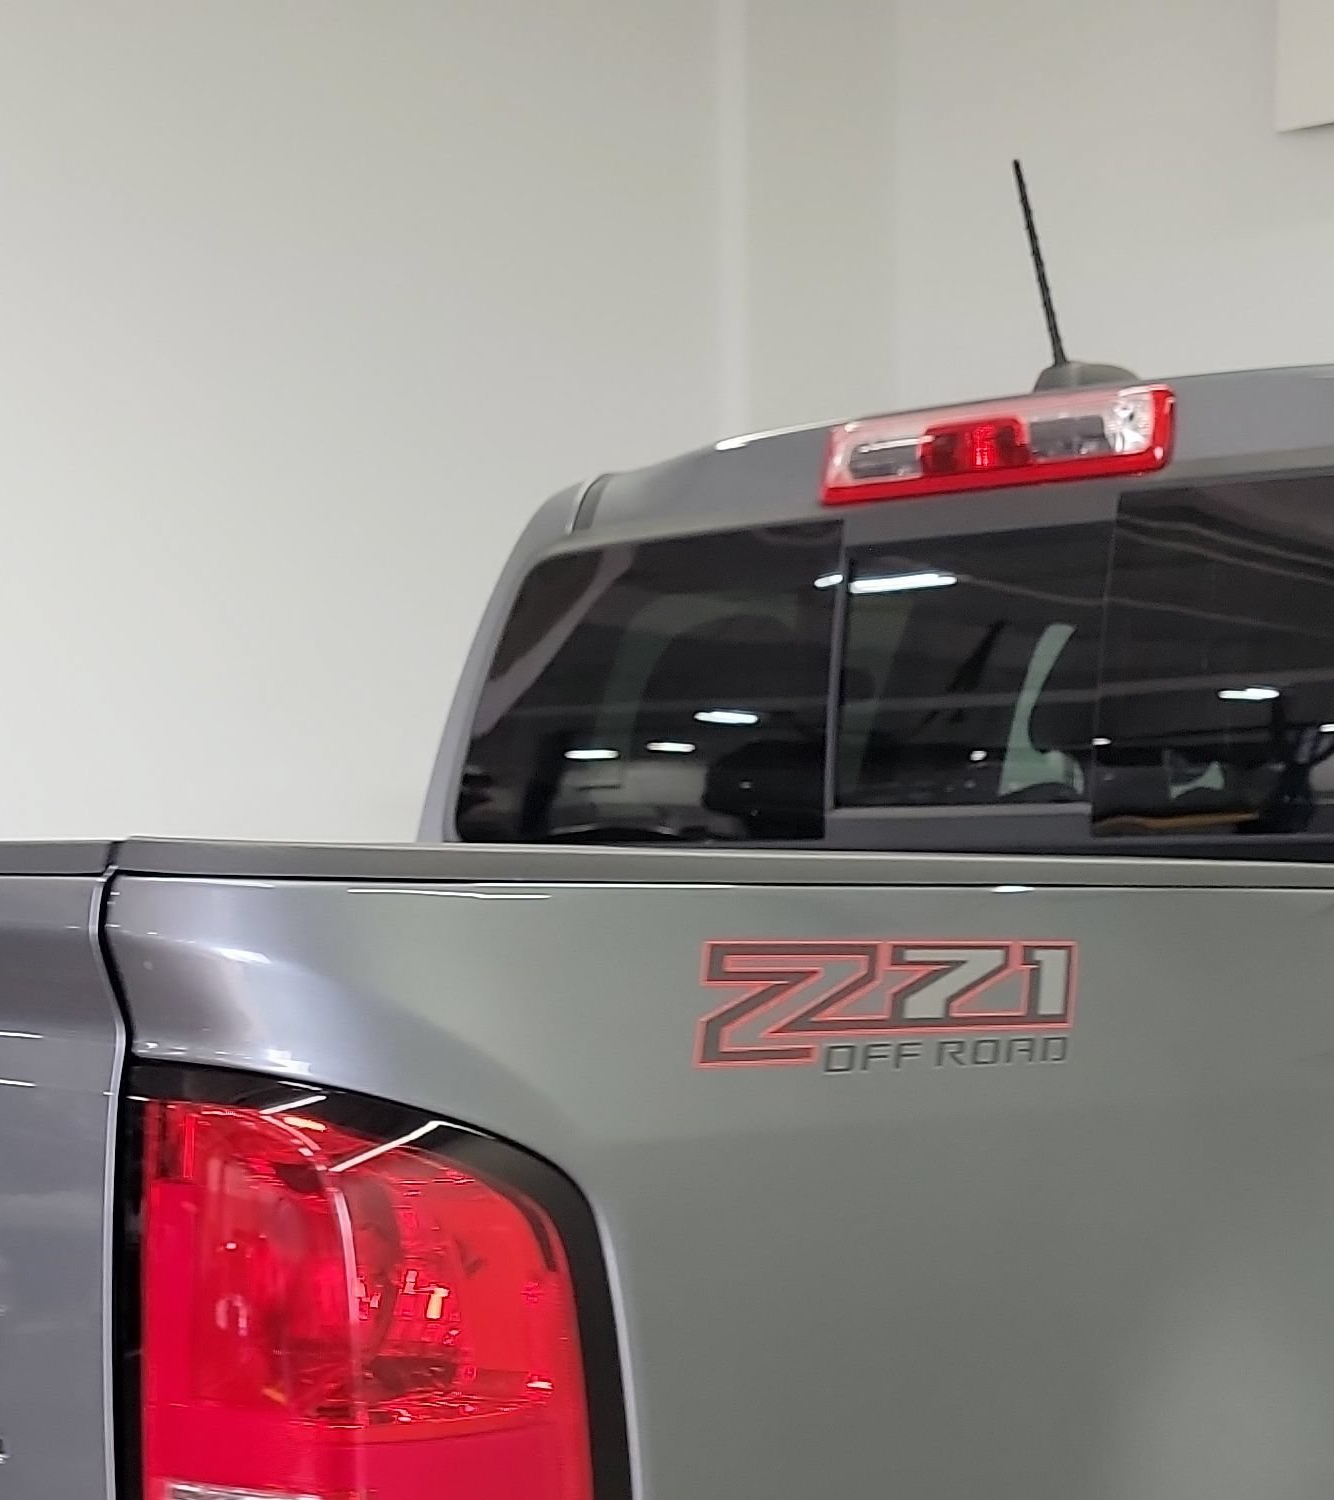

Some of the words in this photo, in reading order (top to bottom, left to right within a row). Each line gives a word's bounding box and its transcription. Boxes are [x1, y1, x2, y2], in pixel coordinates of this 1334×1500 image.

[694, 940, 1077, 1068] Z71
[822, 1041, 923, 1074] OFF
[935, 1036, 1067, 1067] ROAD
